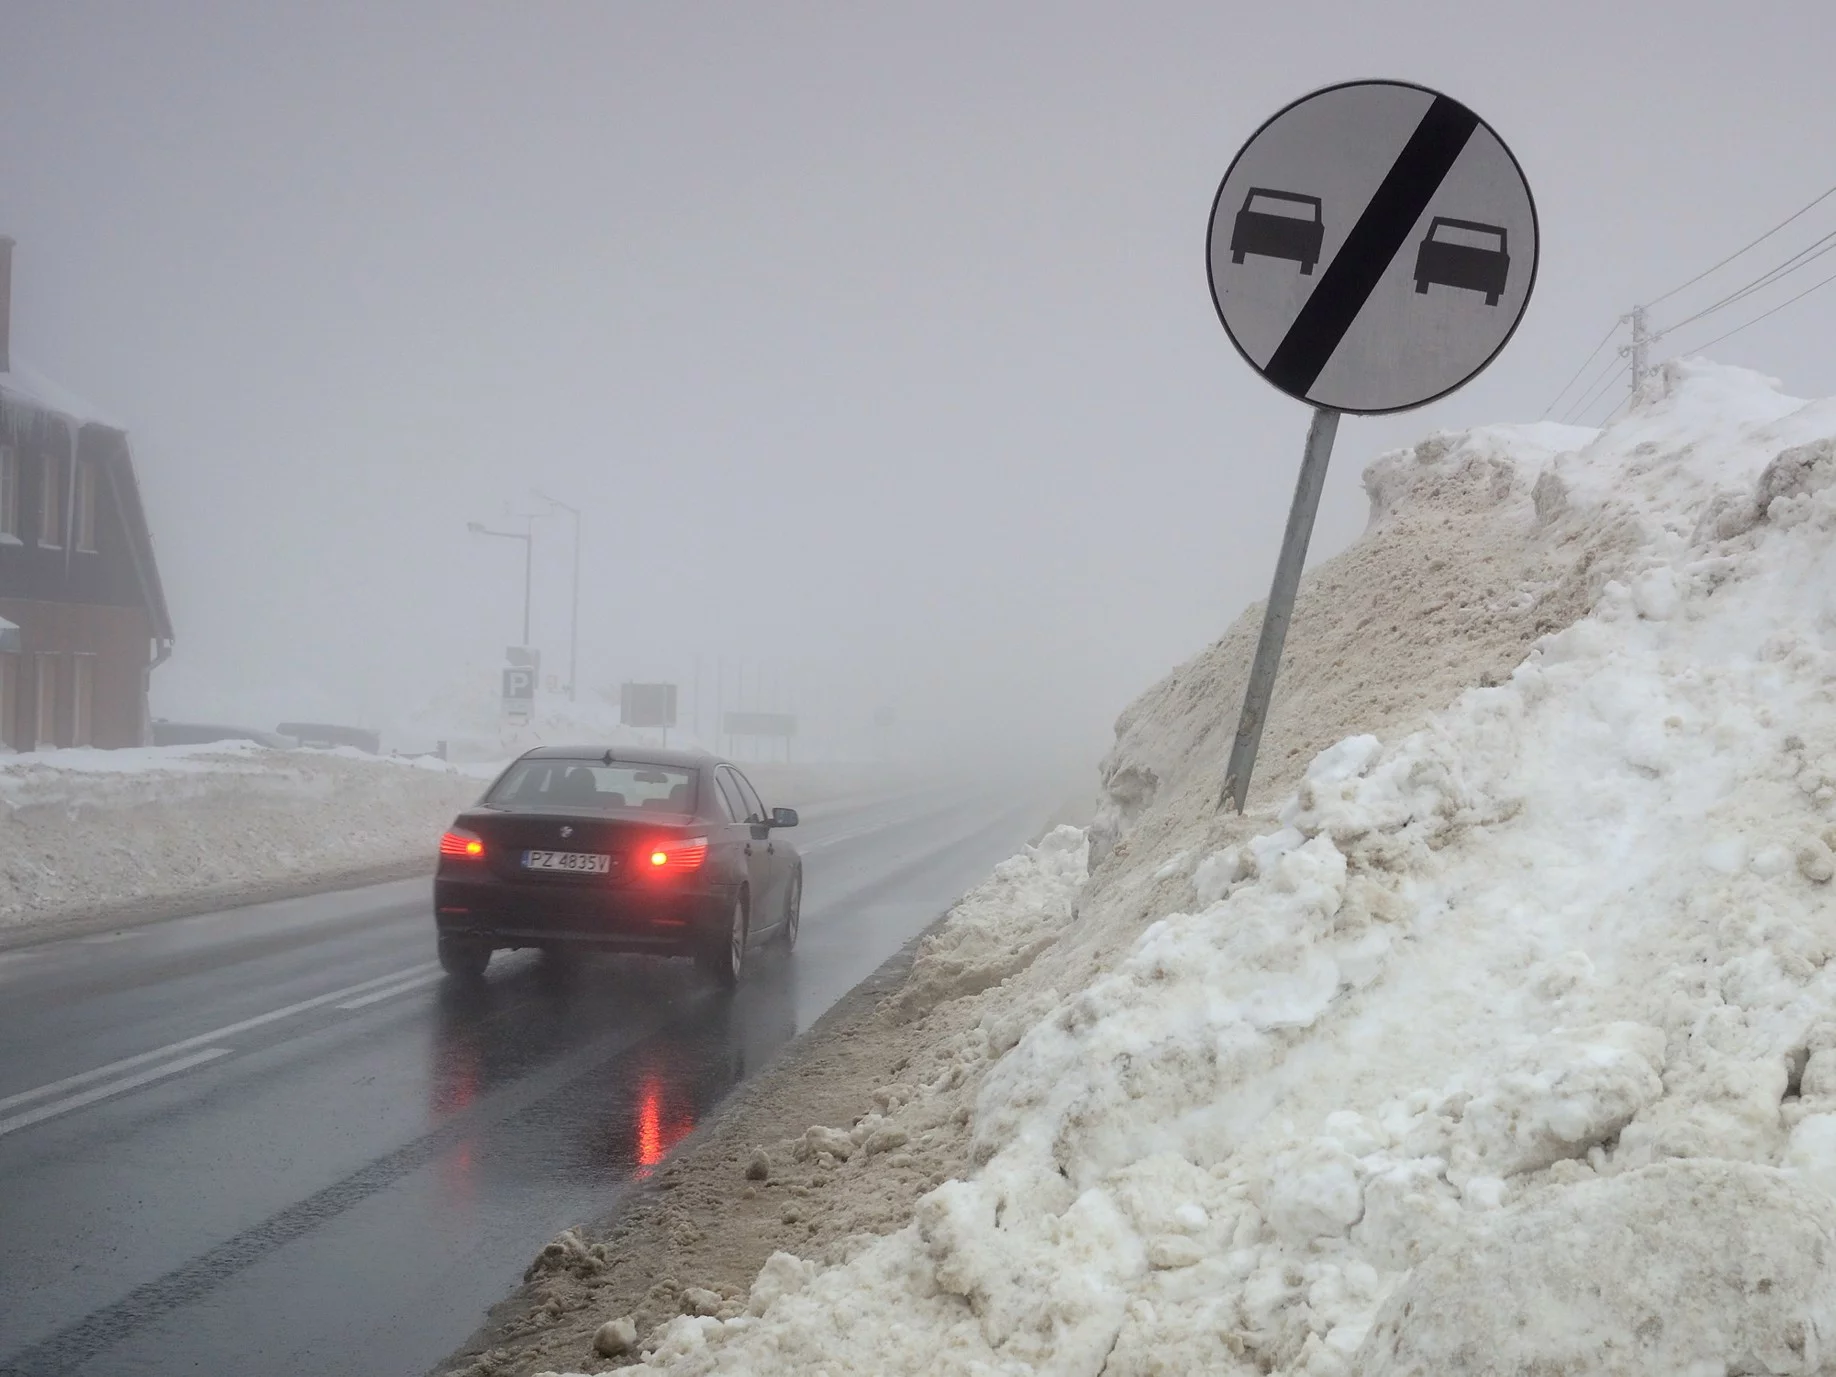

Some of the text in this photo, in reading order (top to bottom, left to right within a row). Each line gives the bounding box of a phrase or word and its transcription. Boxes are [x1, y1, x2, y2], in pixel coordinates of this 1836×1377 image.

[510, 672, 529, 697] P
[532, 852, 607, 870] PZ 4835V
